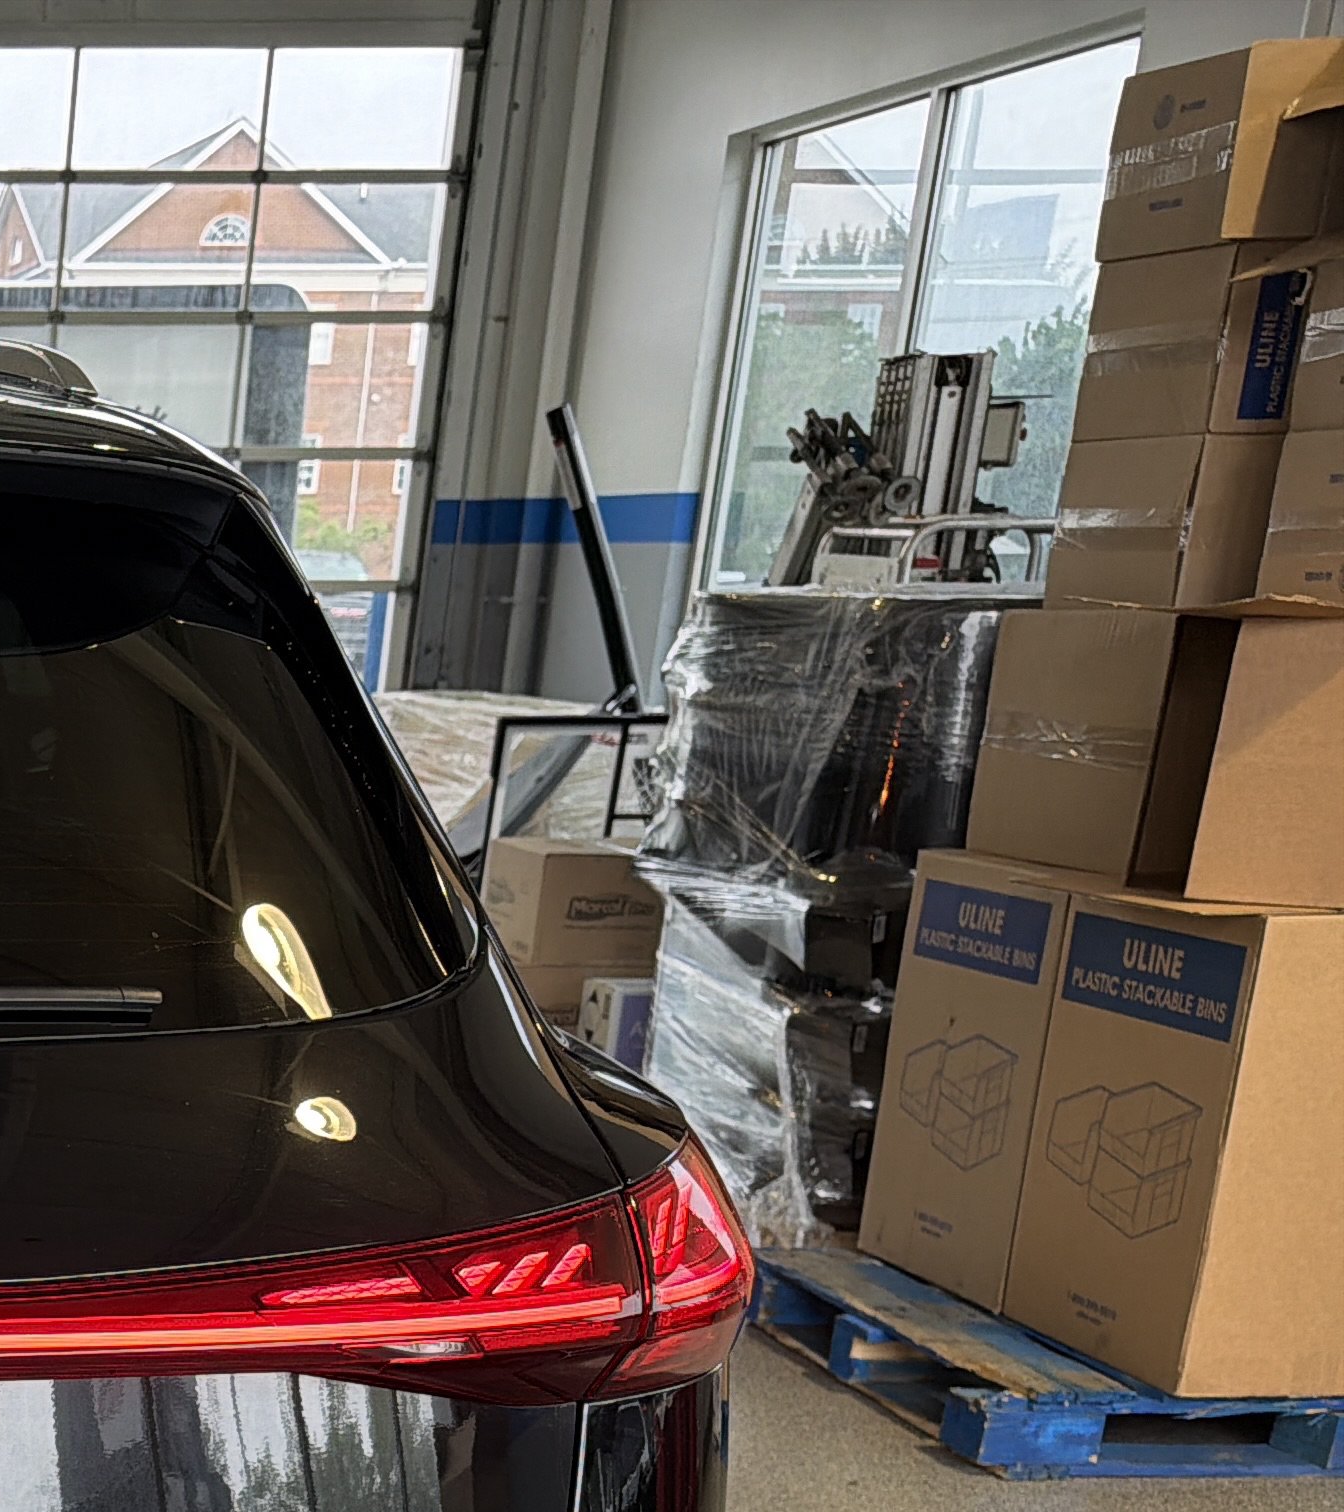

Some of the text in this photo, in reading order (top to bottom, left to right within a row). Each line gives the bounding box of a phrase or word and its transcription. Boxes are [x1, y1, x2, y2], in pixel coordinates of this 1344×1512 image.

[1254, 311, 1279, 368] ULINE
[958, 902, 1005, 936] ULINE
[920, 927, 1037, 971] PLASTIC STACKABLE BINS
[1123, 938, 1185, 980] ULINE
[1071, 966, 1228, 1024] PLASTIC STACKABLE BINS
